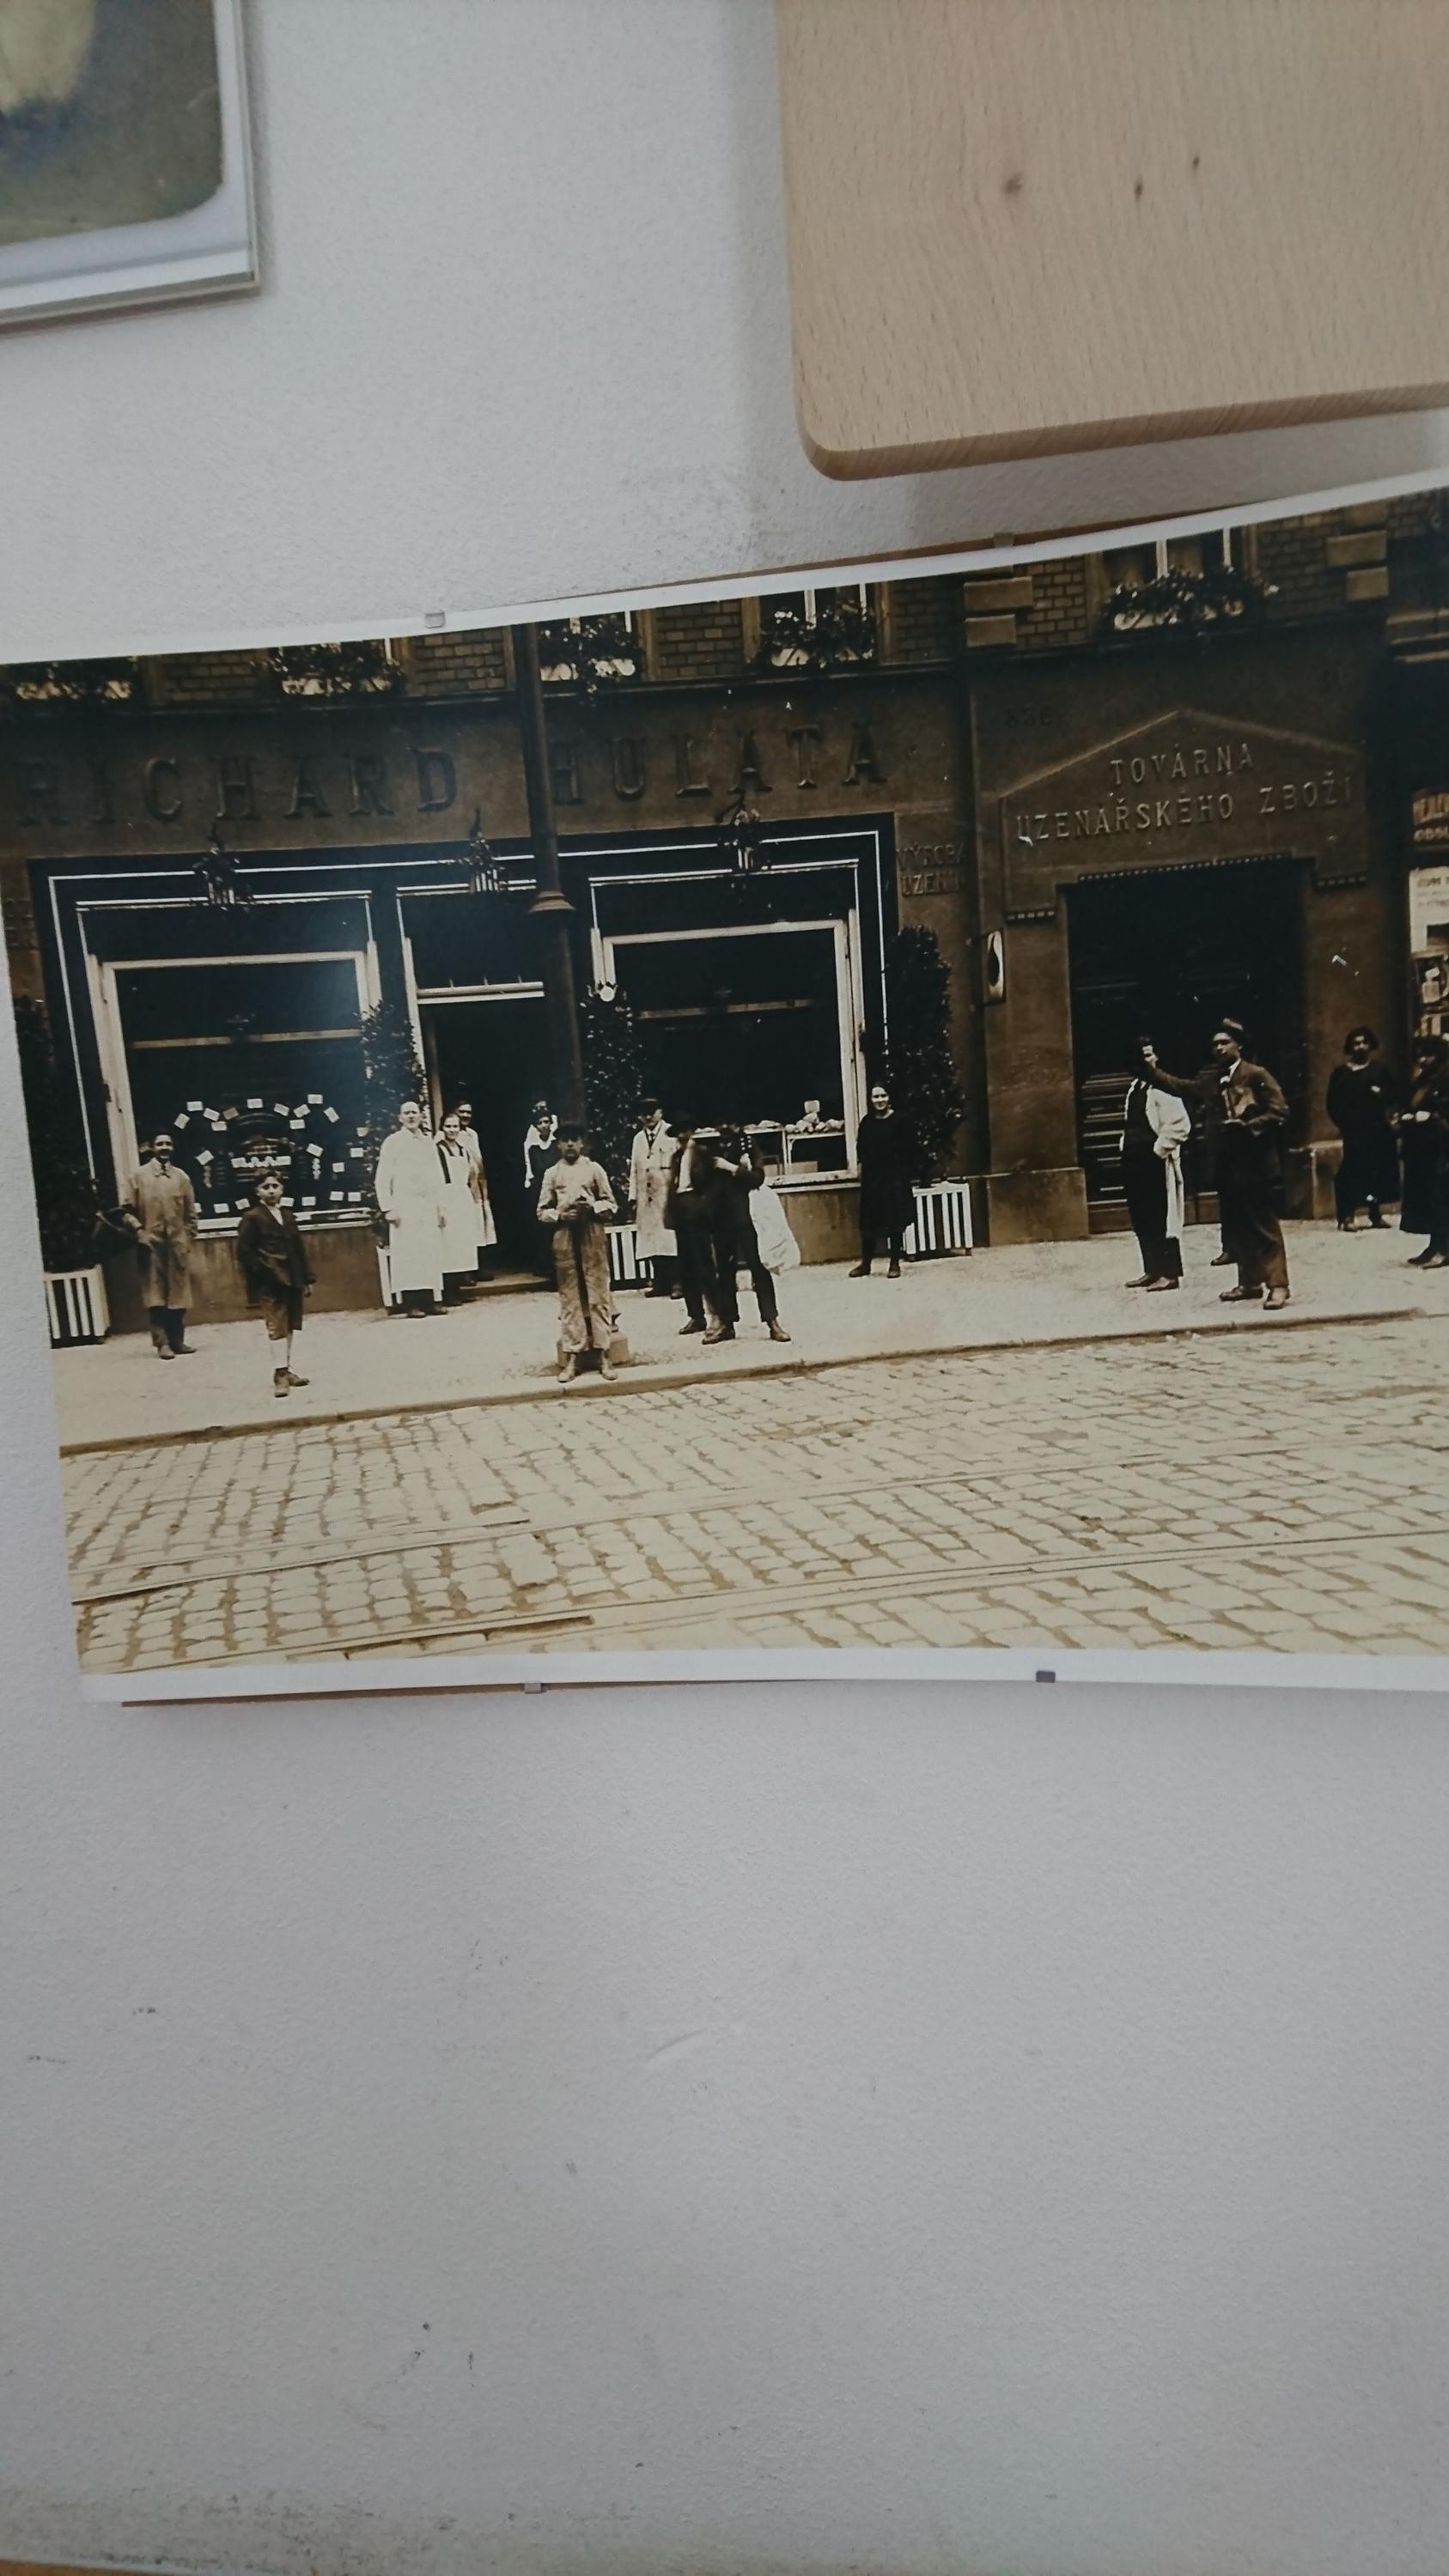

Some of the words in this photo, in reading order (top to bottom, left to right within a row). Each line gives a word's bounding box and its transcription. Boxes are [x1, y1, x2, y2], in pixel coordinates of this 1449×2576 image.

[15, 745, 457, 825] RICHARD
[547, 721, 887, 805] HULATA
[1111, 742, 1255, 787] TOVÁRNA
[1016, 792, 1234, 841] UZENÁŘSKÉHO
[1259, 770, 1354, 815] ZBOŽÍ
